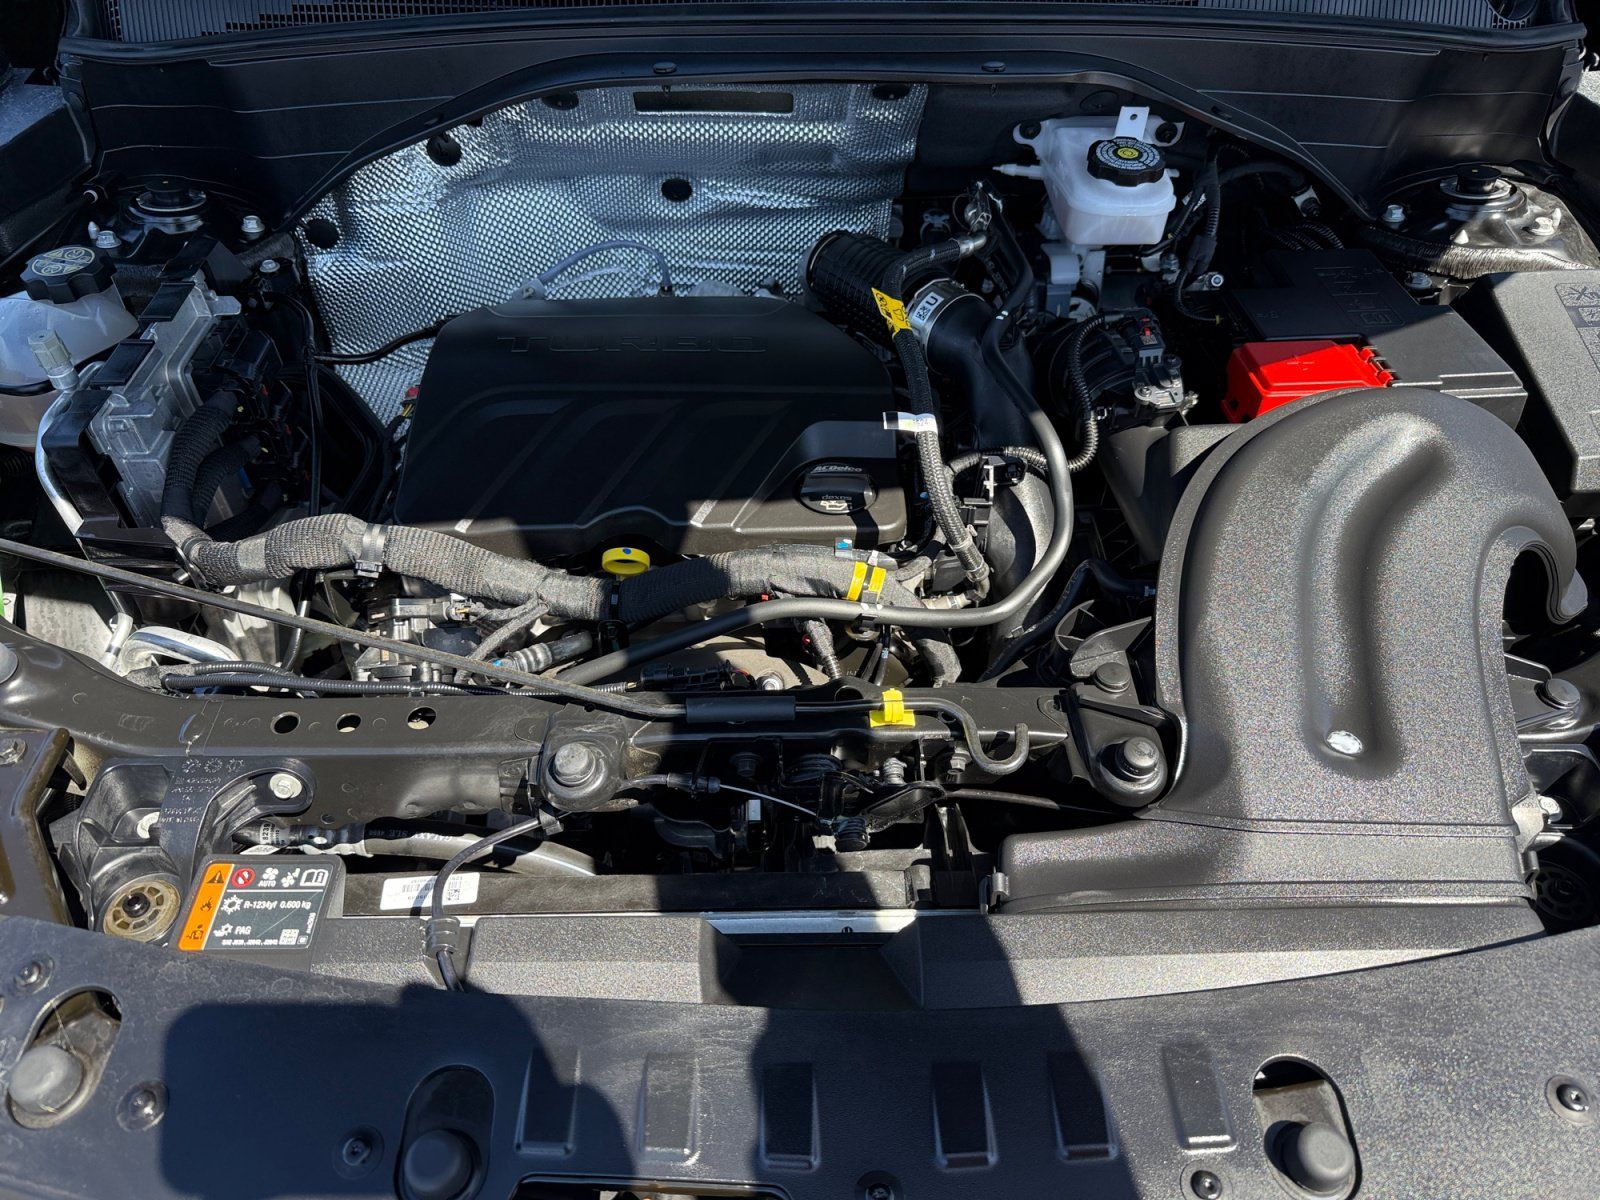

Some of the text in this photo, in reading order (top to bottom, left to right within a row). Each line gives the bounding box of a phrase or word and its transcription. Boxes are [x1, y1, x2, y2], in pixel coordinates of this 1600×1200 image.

[926, 296, 938, 306] U
[496, 335, 767, 353] TURBO
[811, 465, 863, 473] ACDelco
[258, 880, 277, 888] AUTO
[243, 900, 312, 911] R-1234yf 0.600 kg
[234, 925, 252, 936] PAG
